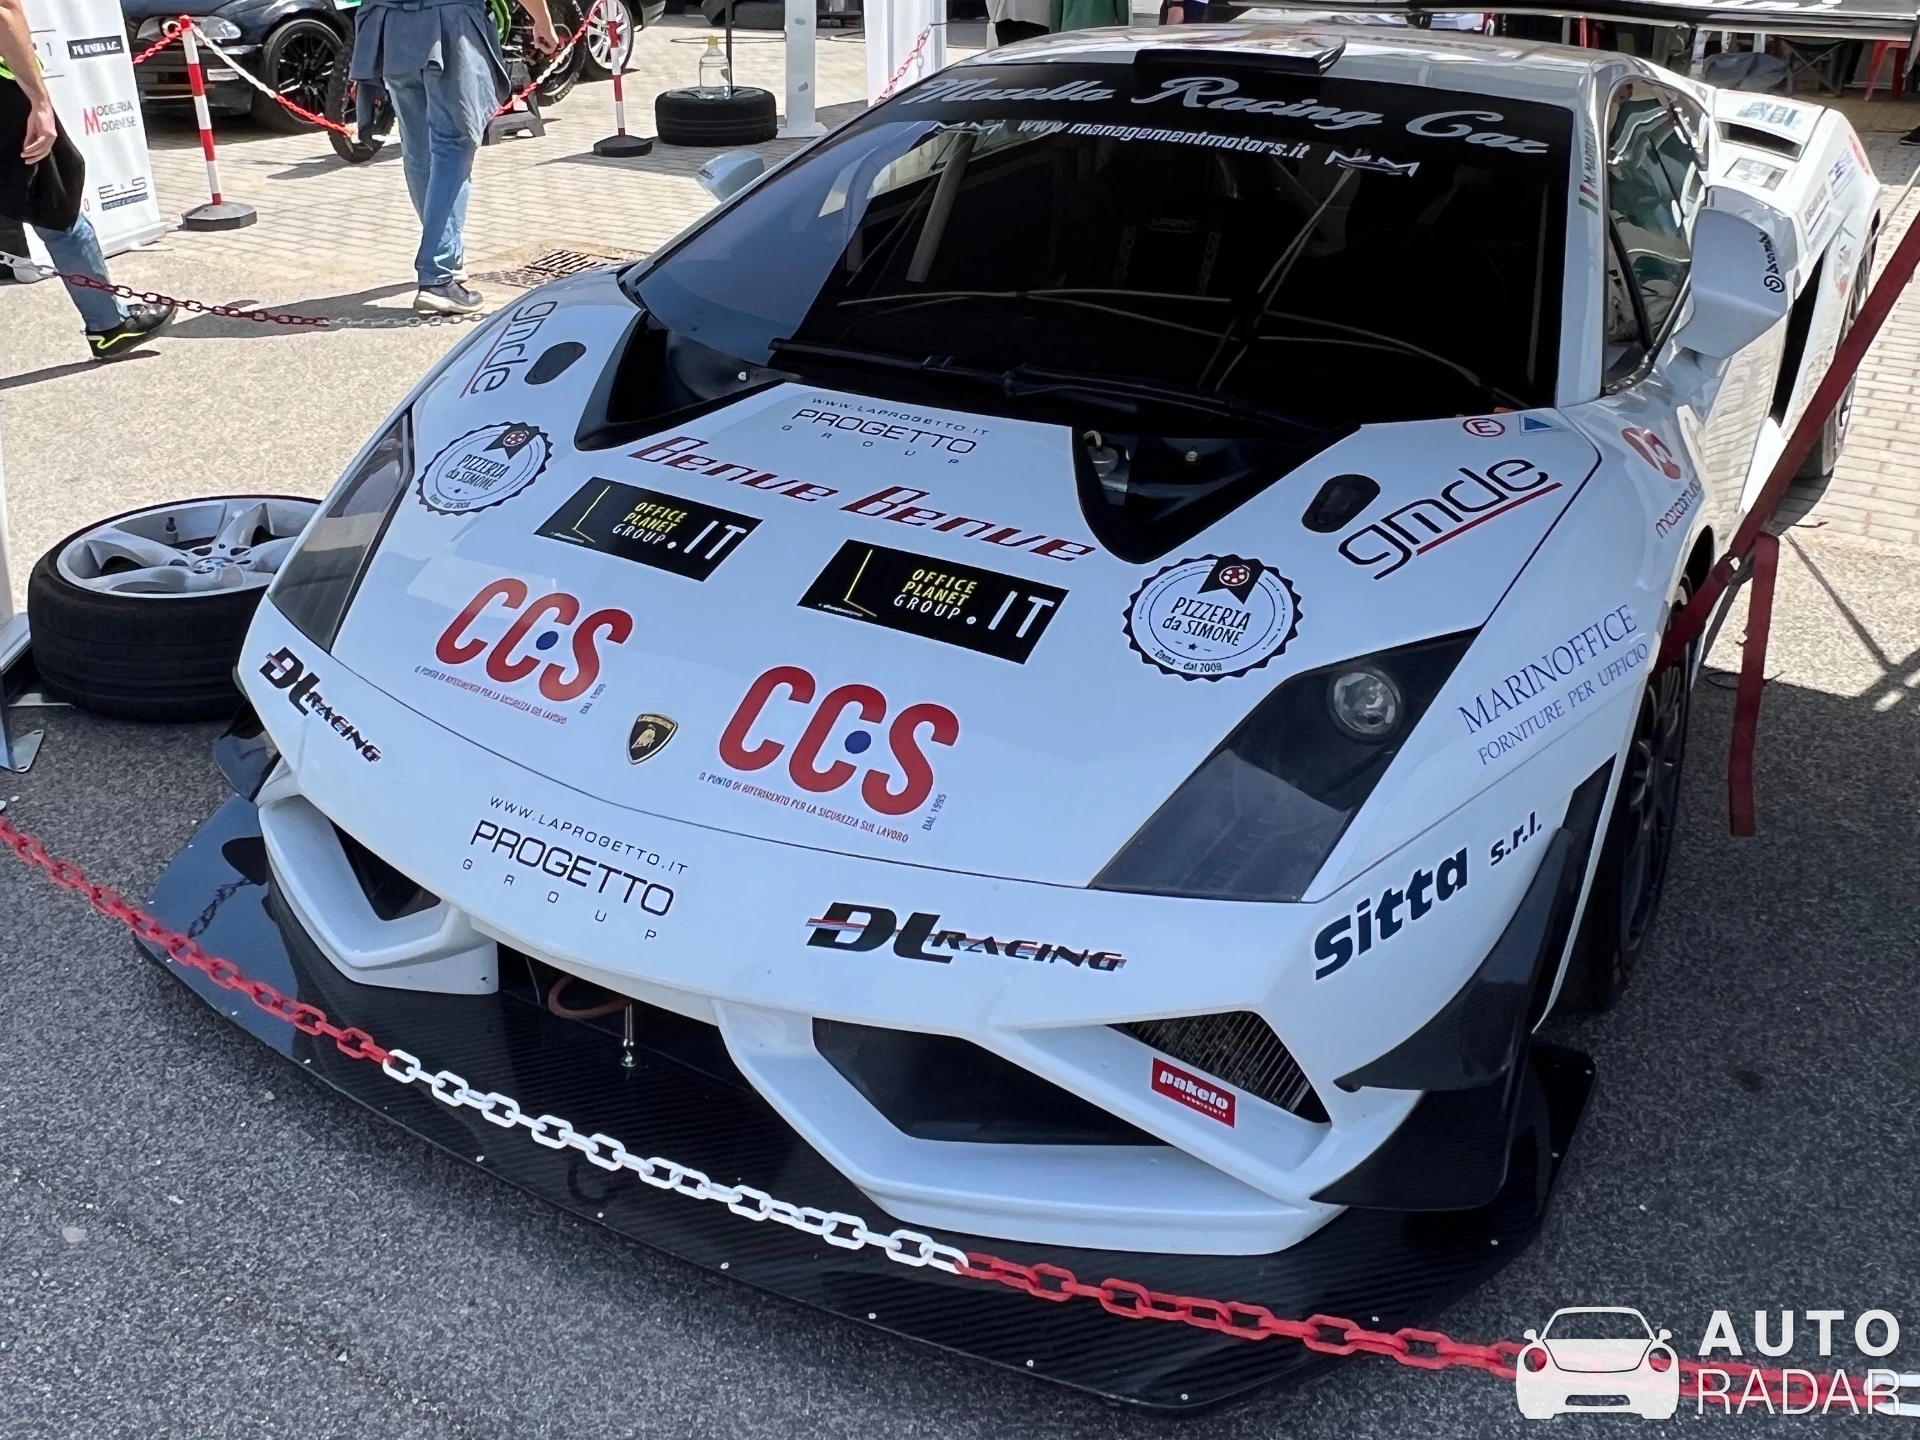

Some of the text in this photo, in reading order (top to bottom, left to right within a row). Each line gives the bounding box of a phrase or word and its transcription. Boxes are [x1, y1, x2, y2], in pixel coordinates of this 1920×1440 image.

[1131, 76, 1384, 130] Racing
[470, 301, 558, 394] gmde
[791, 408, 977, 454] PROGETTO
[456, 453, 511, 479] PIZZERIA
[624, 512, 678, 534] PLANET
[634, 501, 688, 523] OFFICE
[1338, 458, 1549, 581] gmde
[612, 523, 667, 545] GROUP
[901, 581, 970, 607] PLANET
[911, 568, 978, 594] OFFICE
[893, 594, 961, 620] GROUP
[1170, 596, 1252, 631] PIZZERIA
[435, 578, 633, 702] CCS
[1162, 615, 1246, 647] da SIMONE
[1456, 604, 1637, 735] MARINOFFICE
[1477, 643, 1649, 766] FORNITURE PER UFFICIO
[718, 665, 960, 816] CCS
[490, 795, 688, 875] WWW.LAPROGETTO.IT
[876, 823, 909, 843] LAVORO
[469, 819, 675, 917] PROGETTO
[1314, 811, 1543, 981] Sitta s.r.l.
[1160, 1070, 1229, 1110] pakelo
